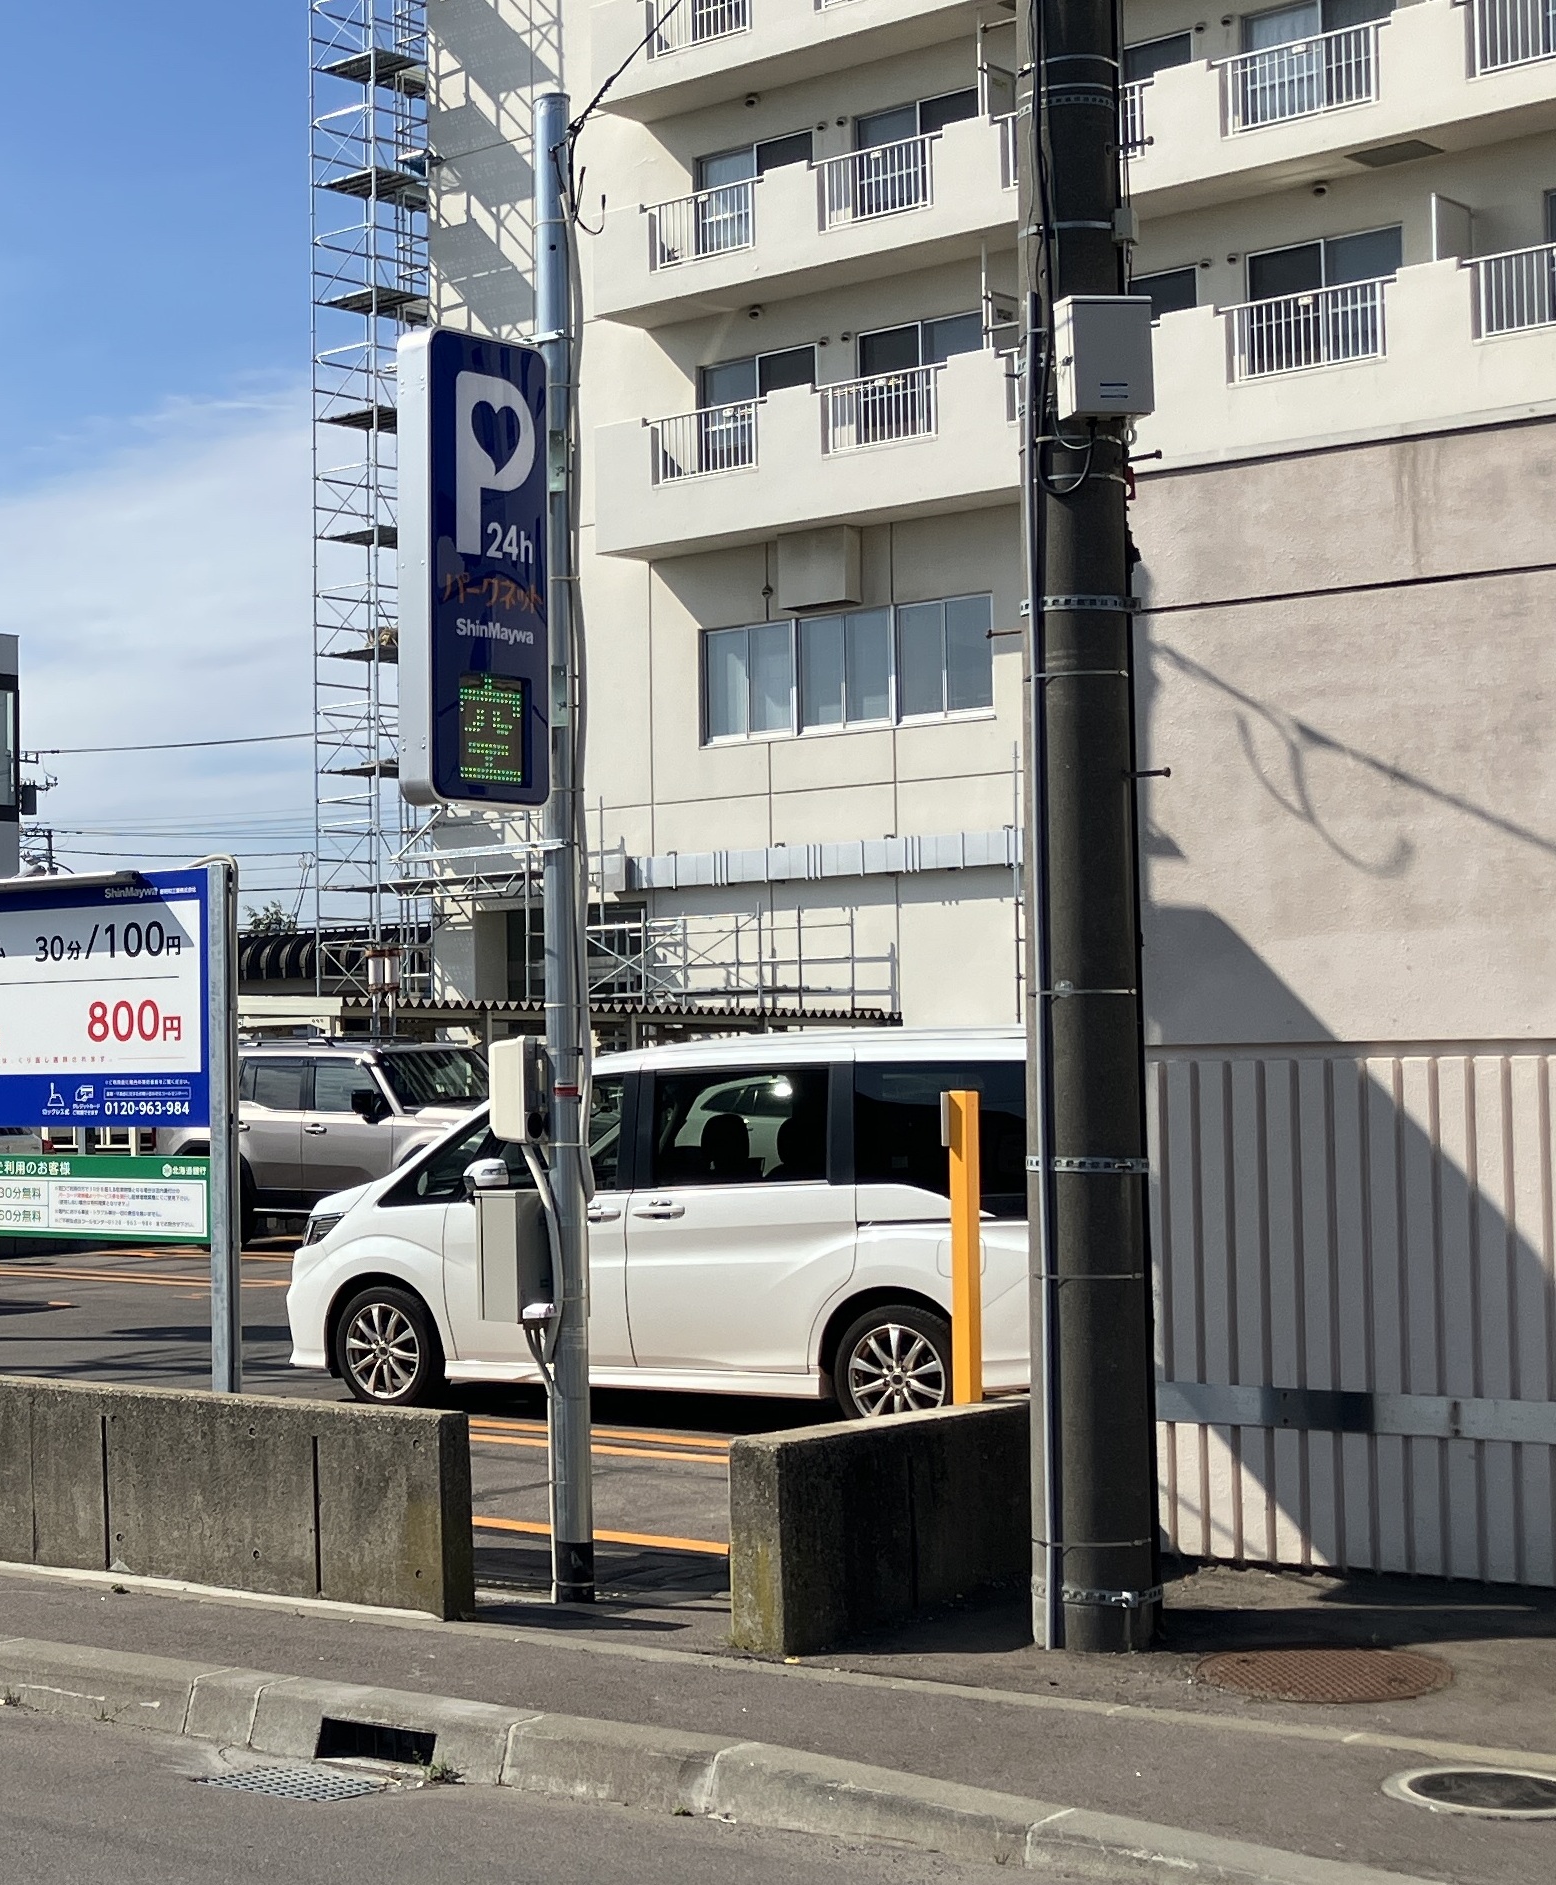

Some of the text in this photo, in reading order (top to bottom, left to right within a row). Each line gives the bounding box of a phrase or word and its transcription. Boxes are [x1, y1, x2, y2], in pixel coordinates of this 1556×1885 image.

[486, 521, 534, 565] 24h
[443, 571, 544, 615] パークネット
[455, 617, 534, 645] ShinMaywa
[459, 673, 522, 784] 空
[104, 886, 159, 899] ShinMaywa
[35, 920, 181, 963] 30分/100円
[87, 999, 182, 1043] 800円
[172, 1166, 207, 1176] 北海道銀行
